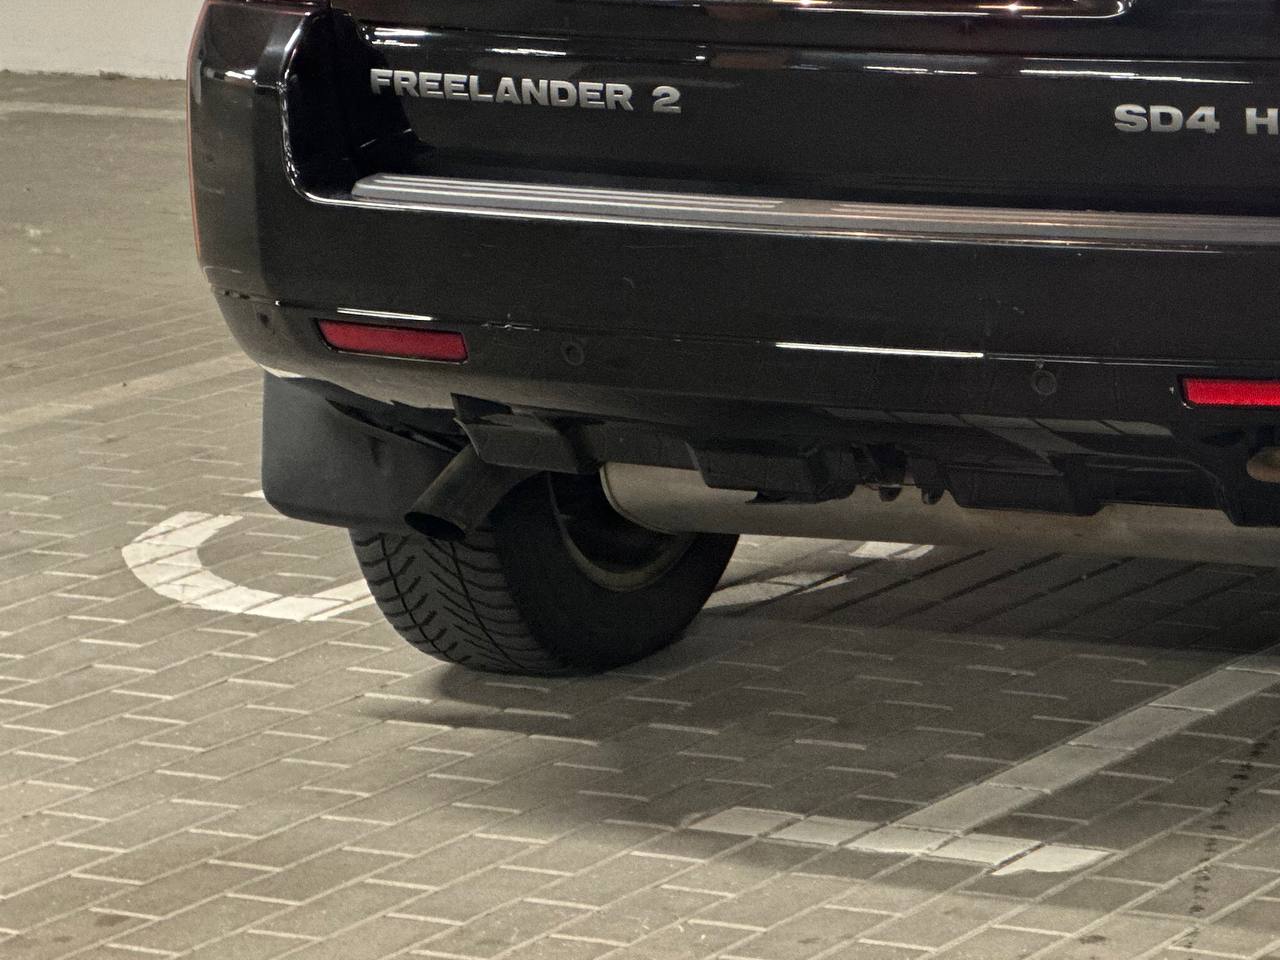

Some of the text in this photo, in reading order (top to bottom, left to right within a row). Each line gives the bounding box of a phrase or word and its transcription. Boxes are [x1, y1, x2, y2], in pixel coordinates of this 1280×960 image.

[370, 68, 682, 114] FREELANDER 2
[1114, 103, 1221, 135] SD4
